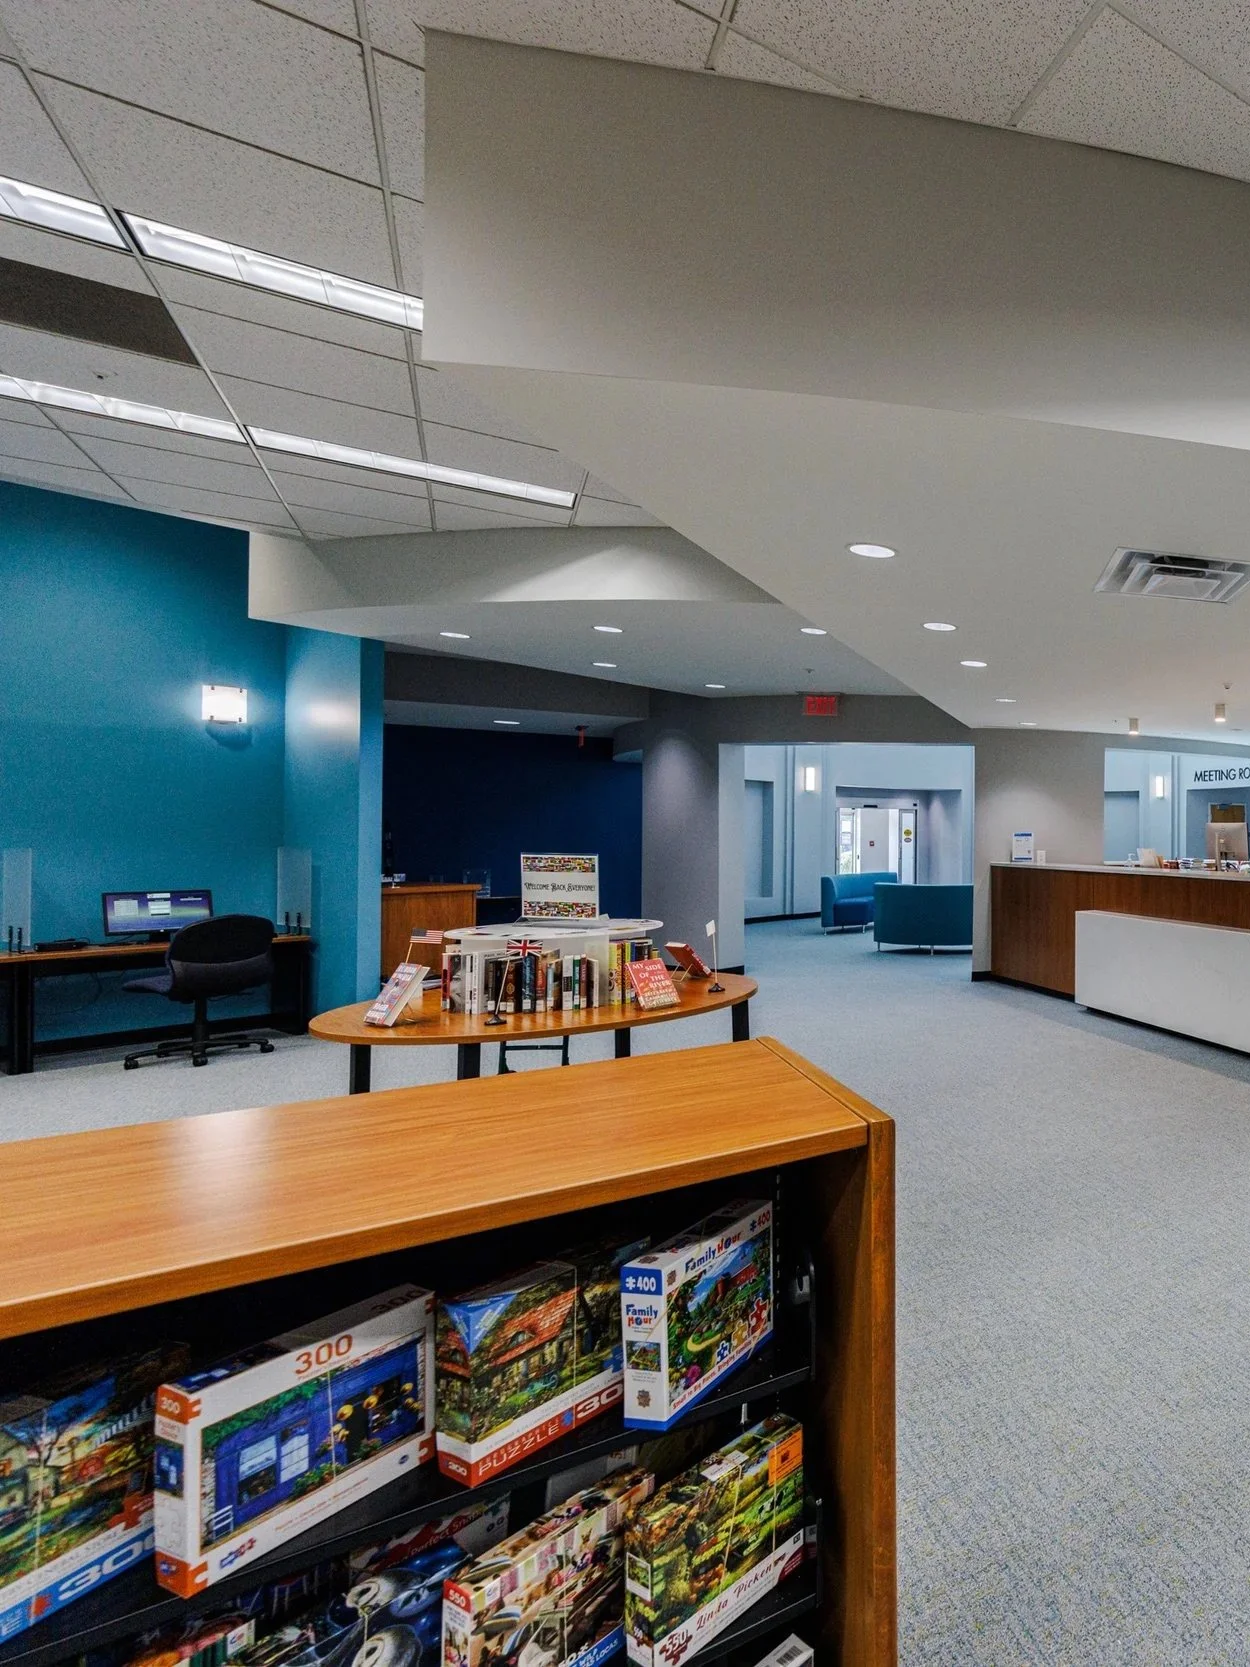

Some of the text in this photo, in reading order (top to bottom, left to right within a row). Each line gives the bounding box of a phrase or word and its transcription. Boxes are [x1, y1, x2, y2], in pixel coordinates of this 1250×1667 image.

[806, 696, 836, 715] EXIT
[1193, 768, 1237, 782] MEETING
[524, 882, 549, 891] WELCOME
[551, 882, 566, 892] BACK
[645, 963, 662, 971] SIDE
[648, 980, 671, 989] RIVER
[650, 974, 666, 982] THE
[756, 1209, 771, 1226] 400
[684, 1231, 742, 1274] Family Hour
[636, 1276, 657, 1292] 400
[625, 1303, 659, 1319] Family
[627, 1316, 653, 1328] Hour
[294, 1333, 354, 1375] 300
[159, 1396, 181, 1415] 300
[479, 1422, 561, 1477] PUZZLE
[447, 1460, 468, 1476] 300
[448, 1590, 467, 1608] 550
[696, 1598, 729, 1631] Linda
[733, 1563, 772, 1599] Picken
[666, 1629, 689, 1655] 550
